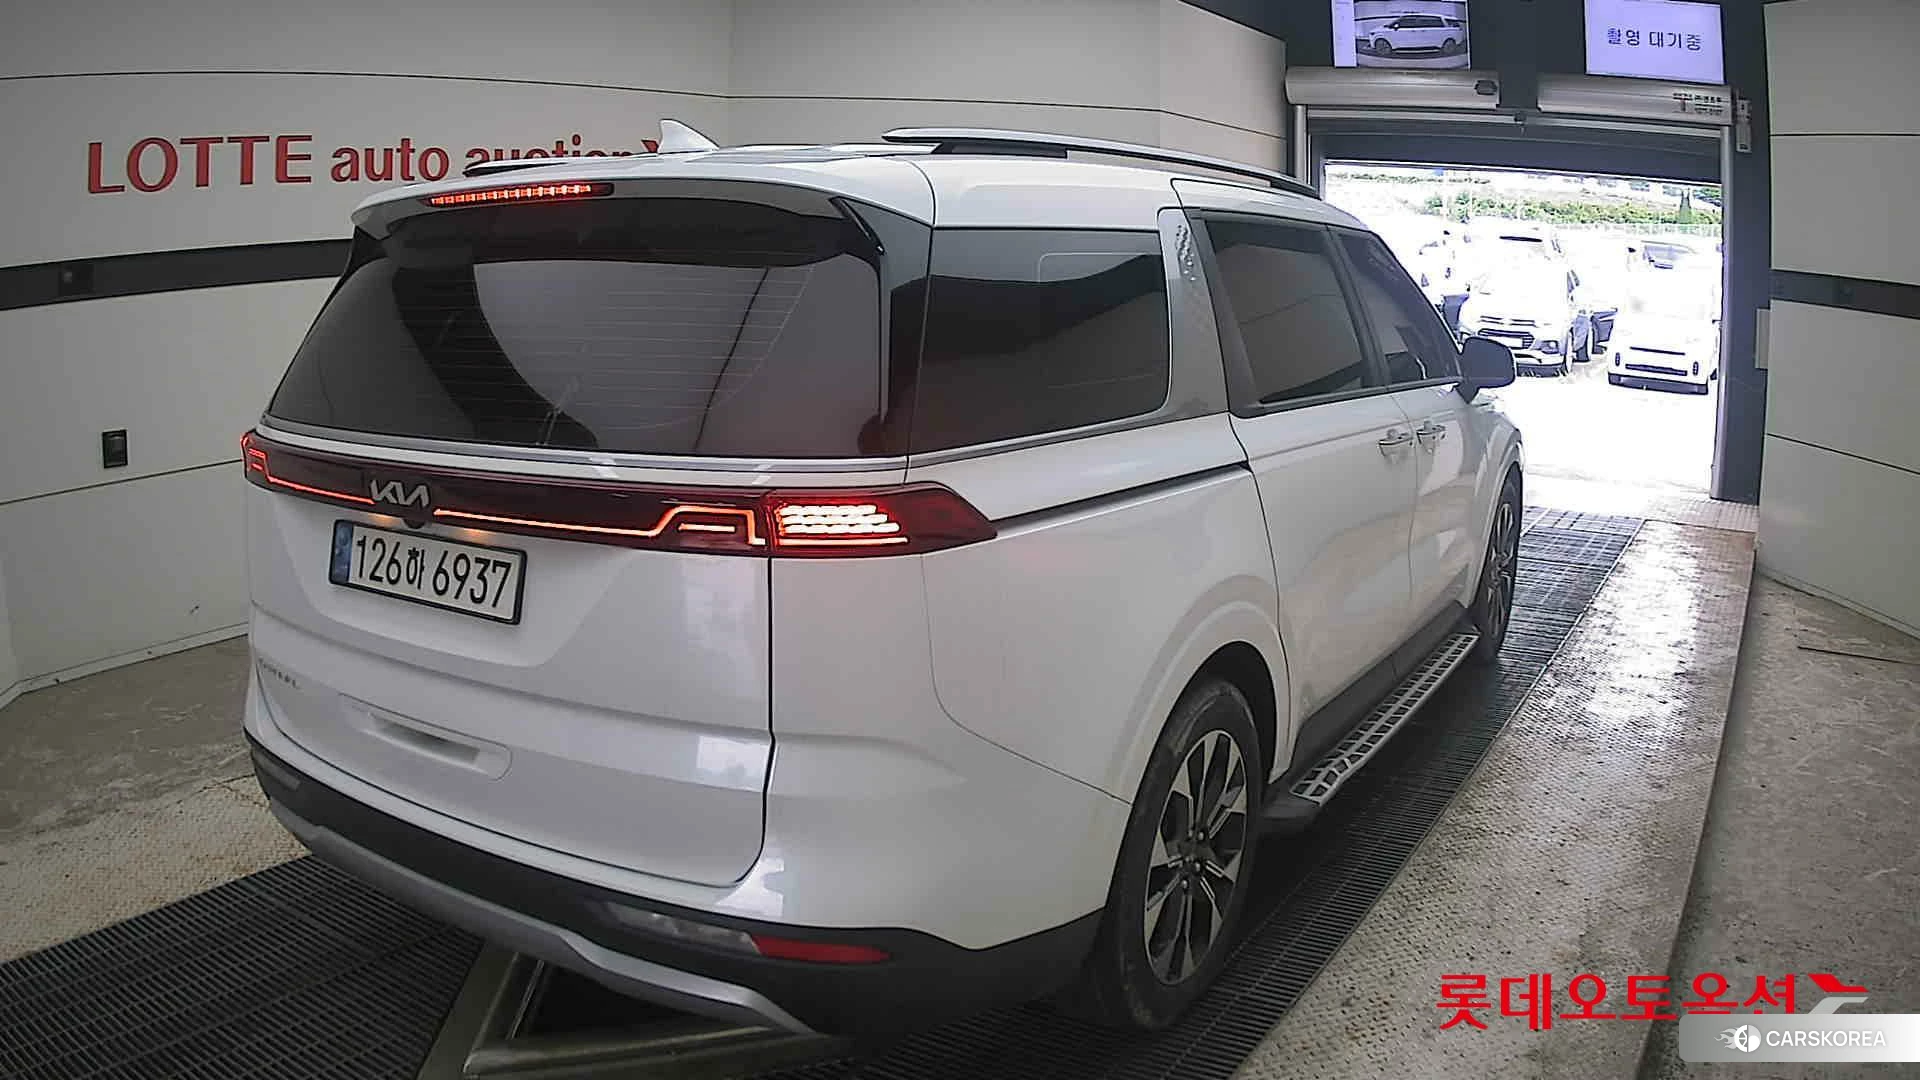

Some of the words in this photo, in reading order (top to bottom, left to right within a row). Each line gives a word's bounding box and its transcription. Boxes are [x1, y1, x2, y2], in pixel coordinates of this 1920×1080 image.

[1607, 27, 1640, 46] 촬영
[88, 135, 312, 194] LOTTE
[330, 138, 450, 182] auto
[357, 535, 425, 590] 126하
[432, 550, 512, 608] 6937
